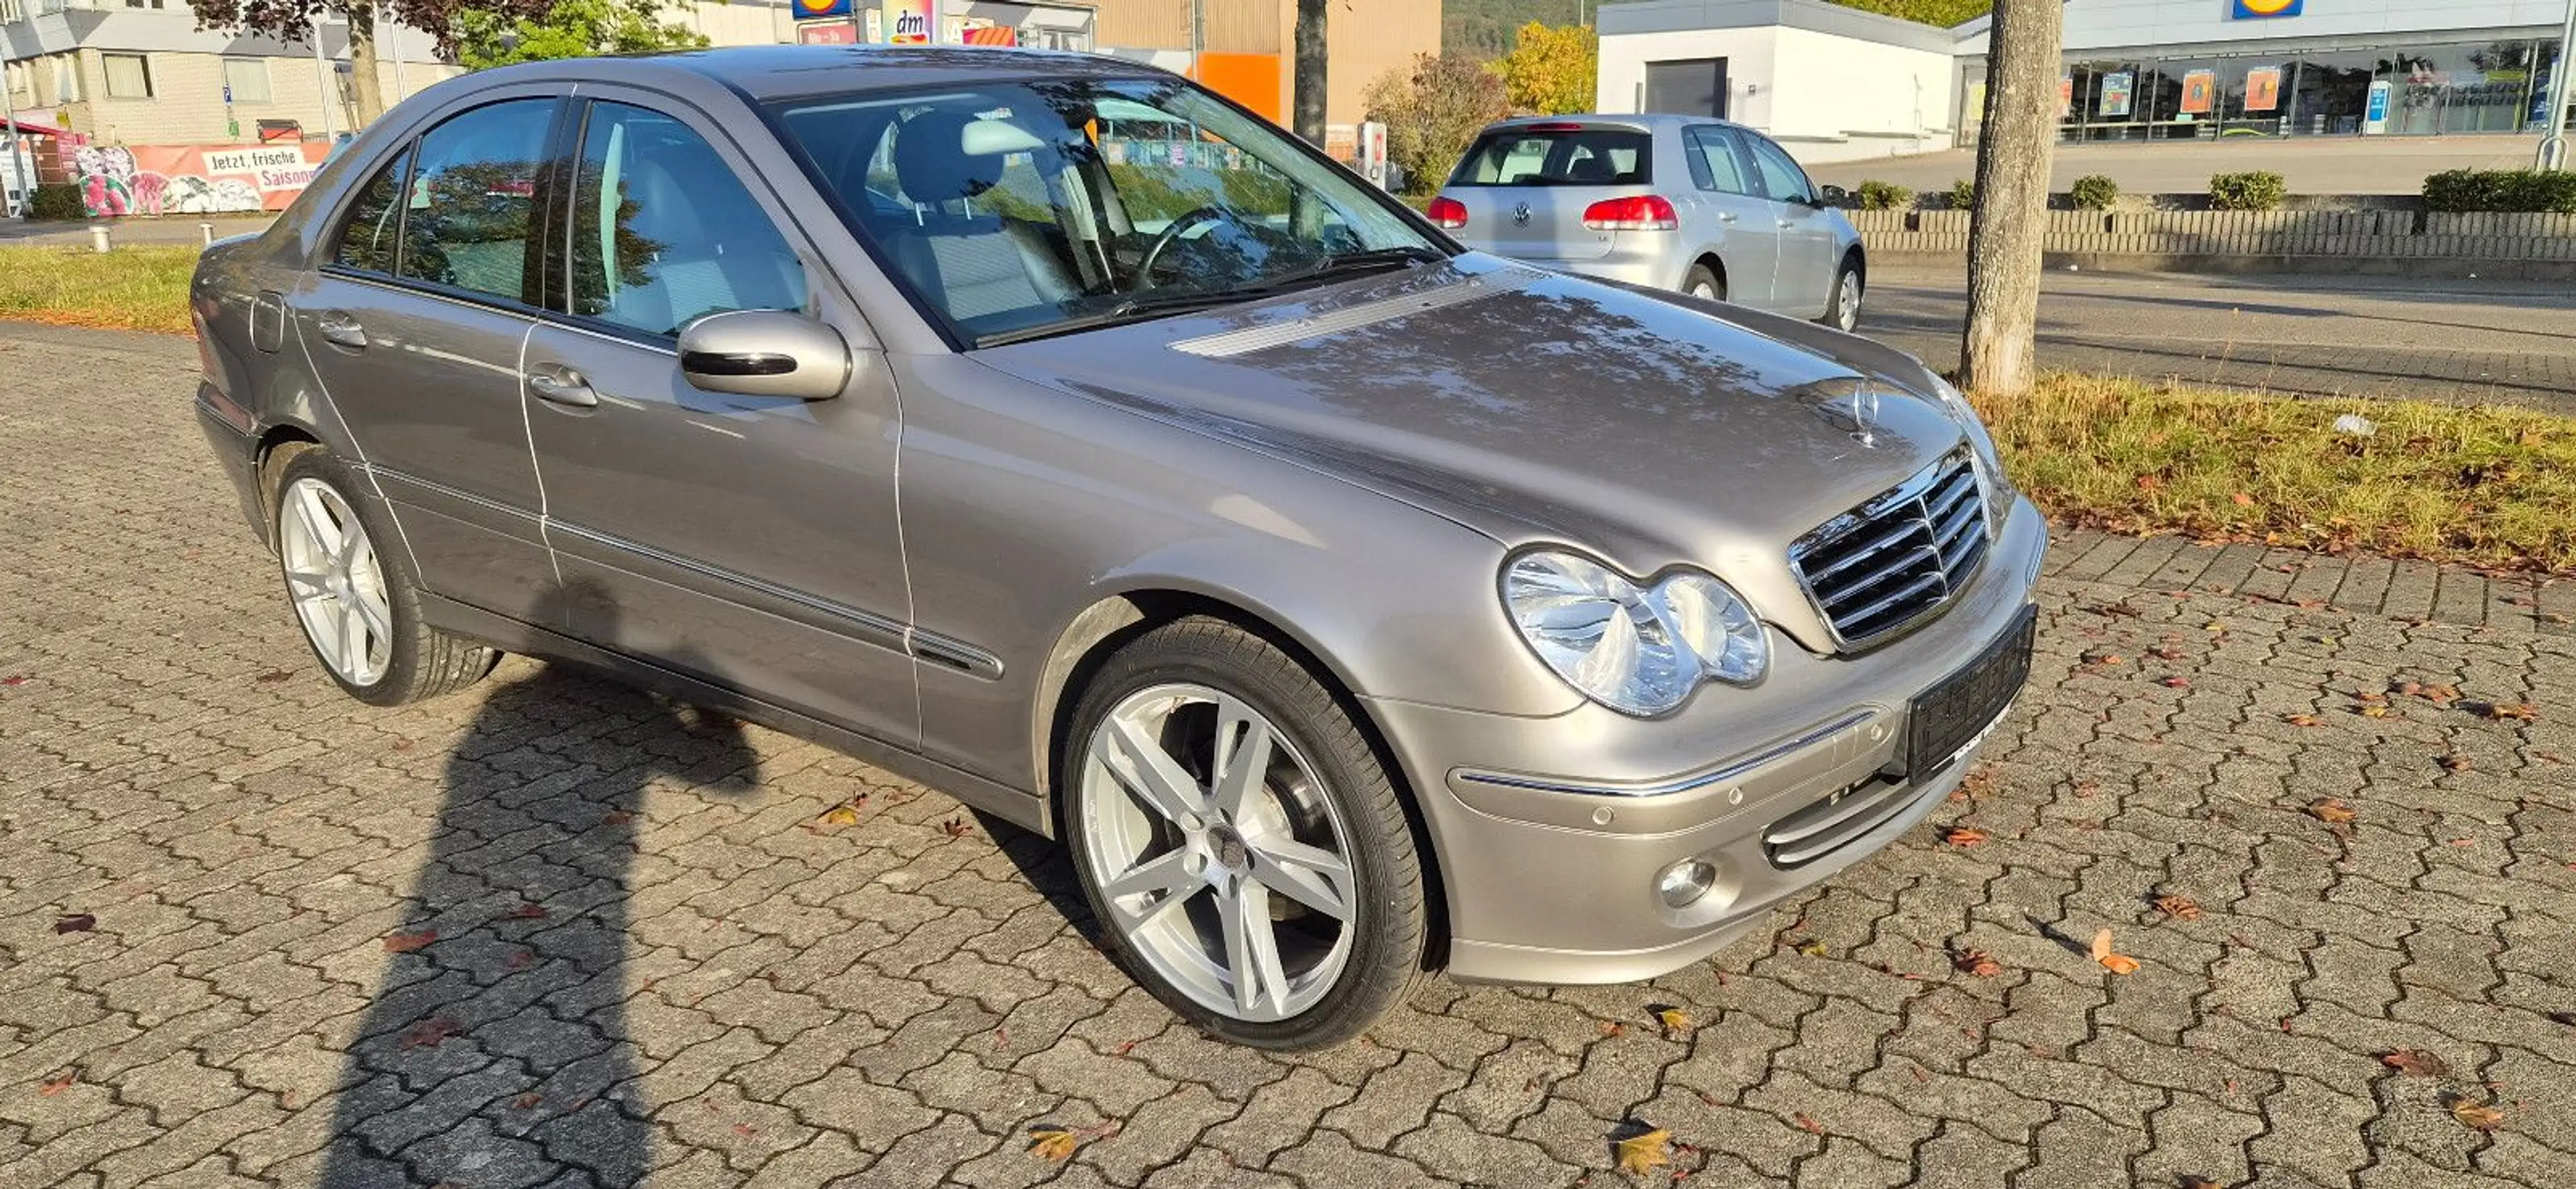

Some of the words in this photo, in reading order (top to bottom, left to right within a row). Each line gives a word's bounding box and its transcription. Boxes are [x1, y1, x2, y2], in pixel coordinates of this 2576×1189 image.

[897, 9, 924, 34] dm
[212, 154, 251, 170] Jetzt,
[252, 152, 296, 166] frische
